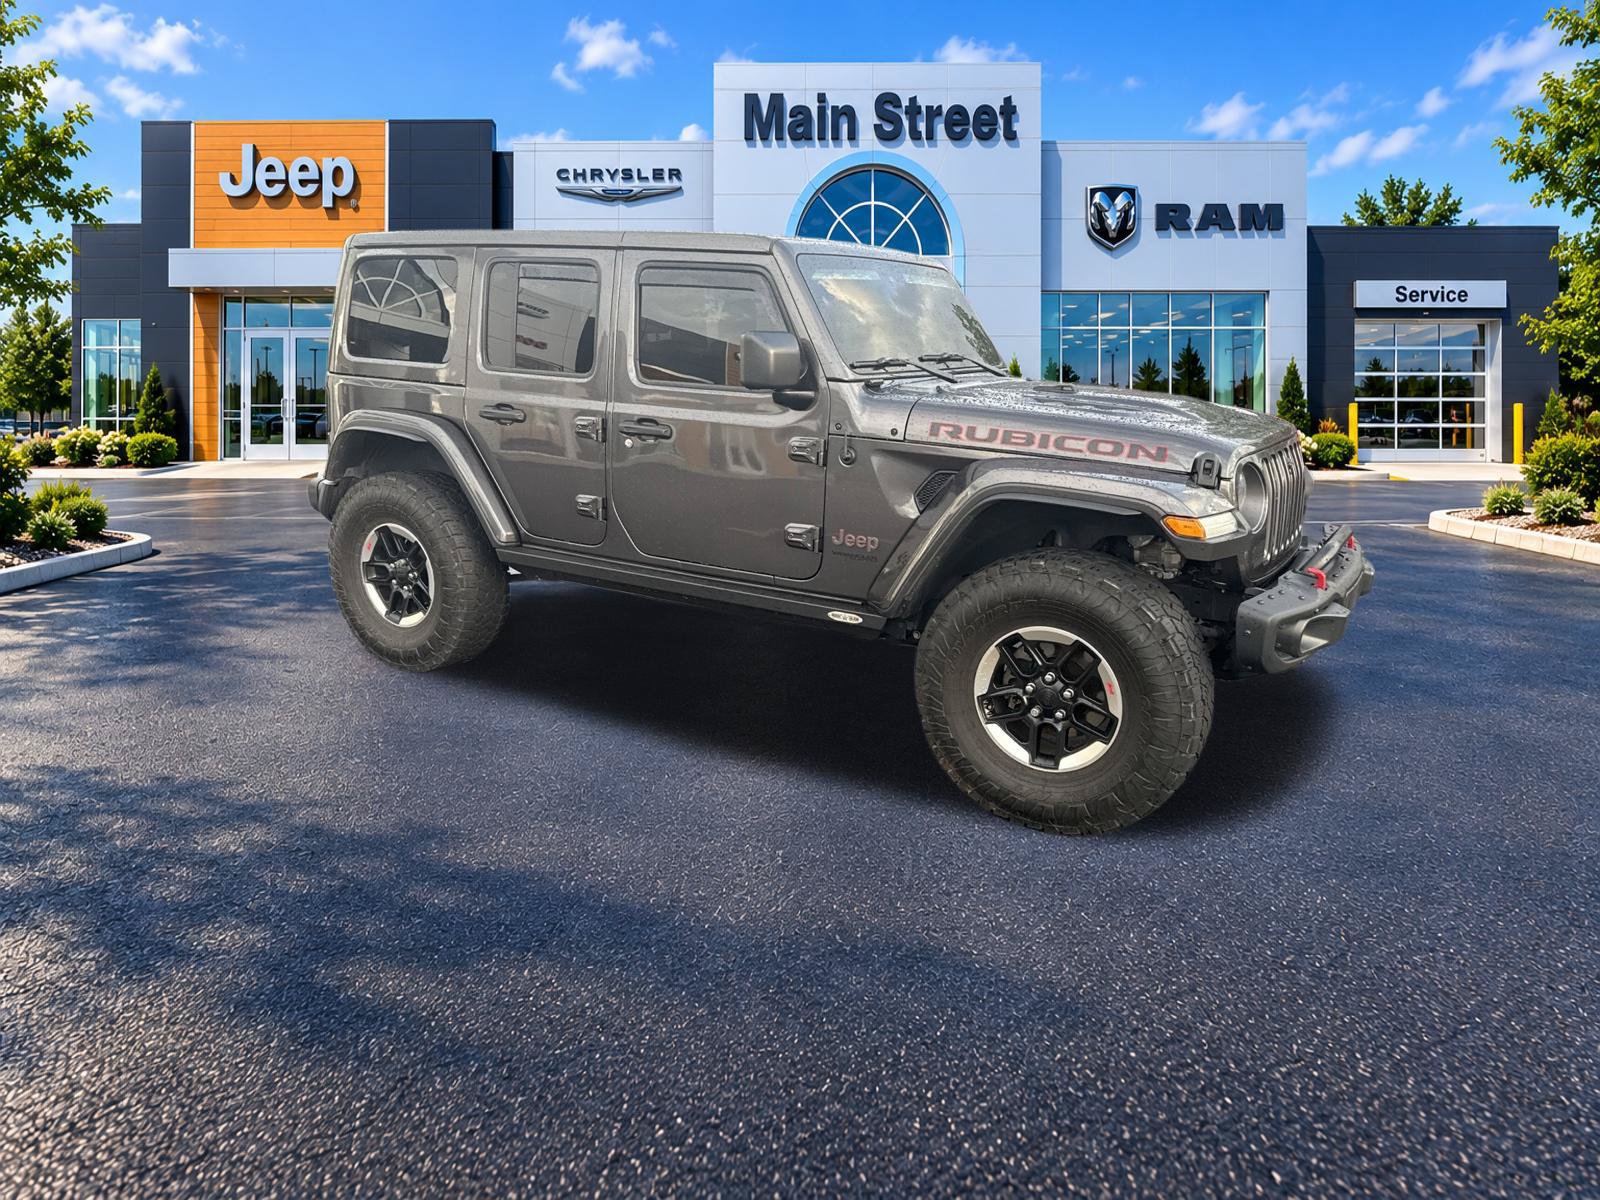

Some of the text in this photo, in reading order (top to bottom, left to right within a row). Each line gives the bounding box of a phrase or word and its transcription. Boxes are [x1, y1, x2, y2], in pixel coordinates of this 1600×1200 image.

[744, 92, 1018, 142] Main Street
[218, 143, 355, 210] Jeep
[556, 168, 683, 182] CHRYSLER
[1155, 203, 1284, 231] RAM
[1395, 285, 1469, 303] Service
[928, 421, 1169, 463] RUBICON
[831, 528, 879, 552] Jeep
